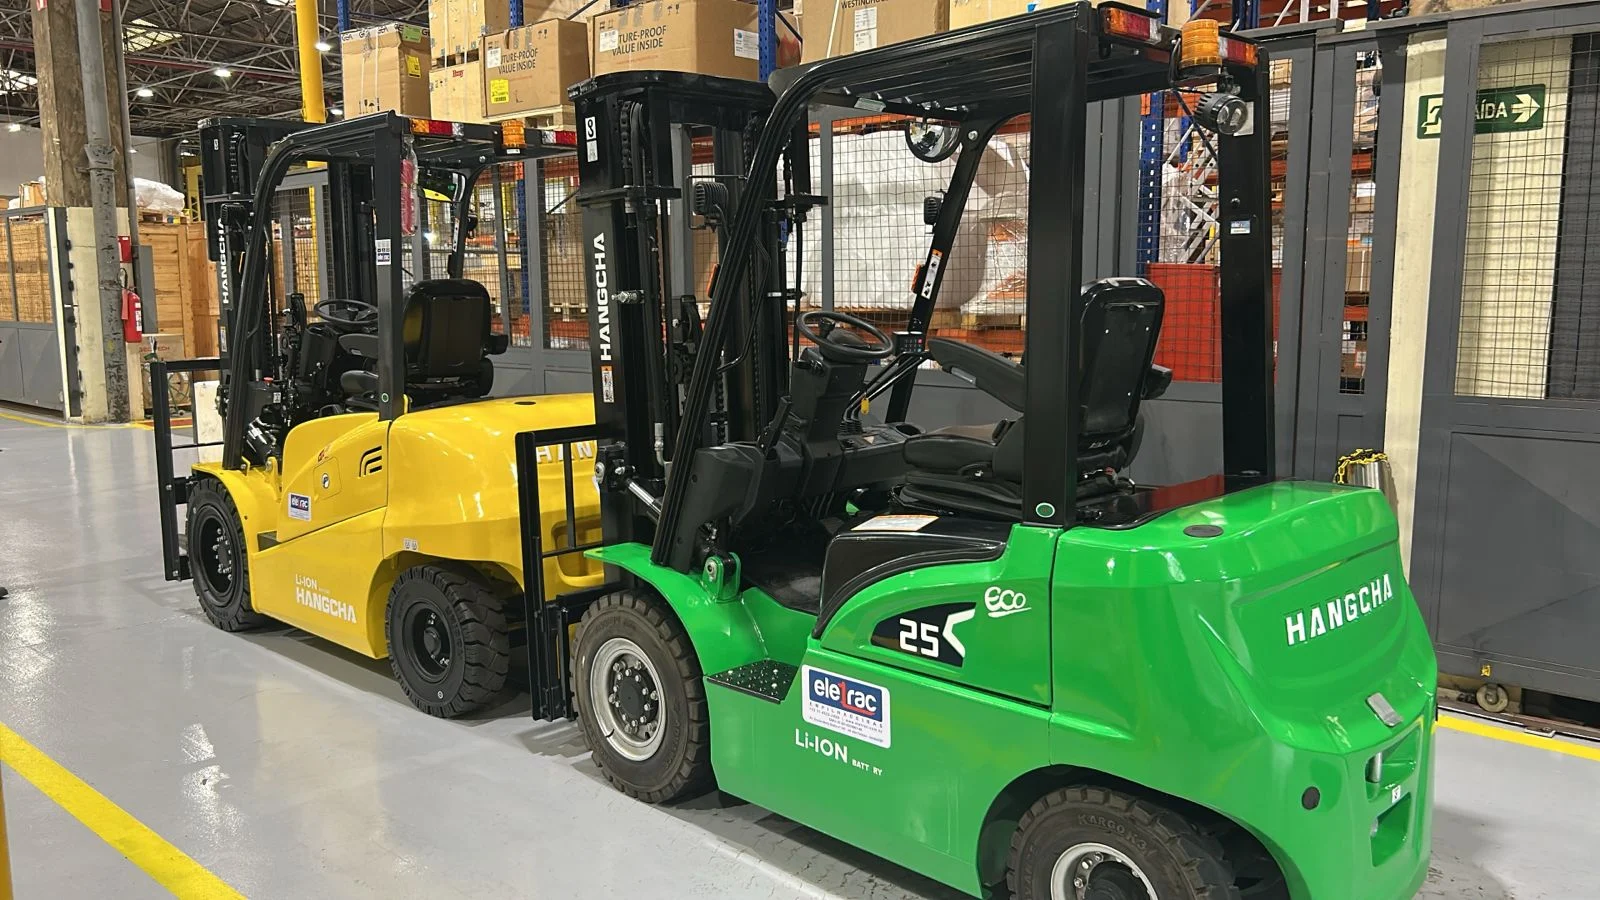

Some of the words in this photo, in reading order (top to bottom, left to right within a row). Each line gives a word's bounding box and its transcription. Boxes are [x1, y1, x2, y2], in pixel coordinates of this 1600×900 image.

[612, 43, 636, 57] VALUE
[637, 37, 664, 52] INSIDE
[617, 25, 667, 44] TURE-PROOF
[498, 62, 516, 75] VALUE
[516, 59, 536, 73] INSIDE
[500, 48, 538, 65] UTURE-PROOF
[593, 232, 612, 361] HANGCHA
[296, 586, 357, 624] HANGCHA
[1286, 573, 1393, 646] HANGCHA
[899, 618, 939, 658] 25
[795, 728, 848, 763] Li-ION
